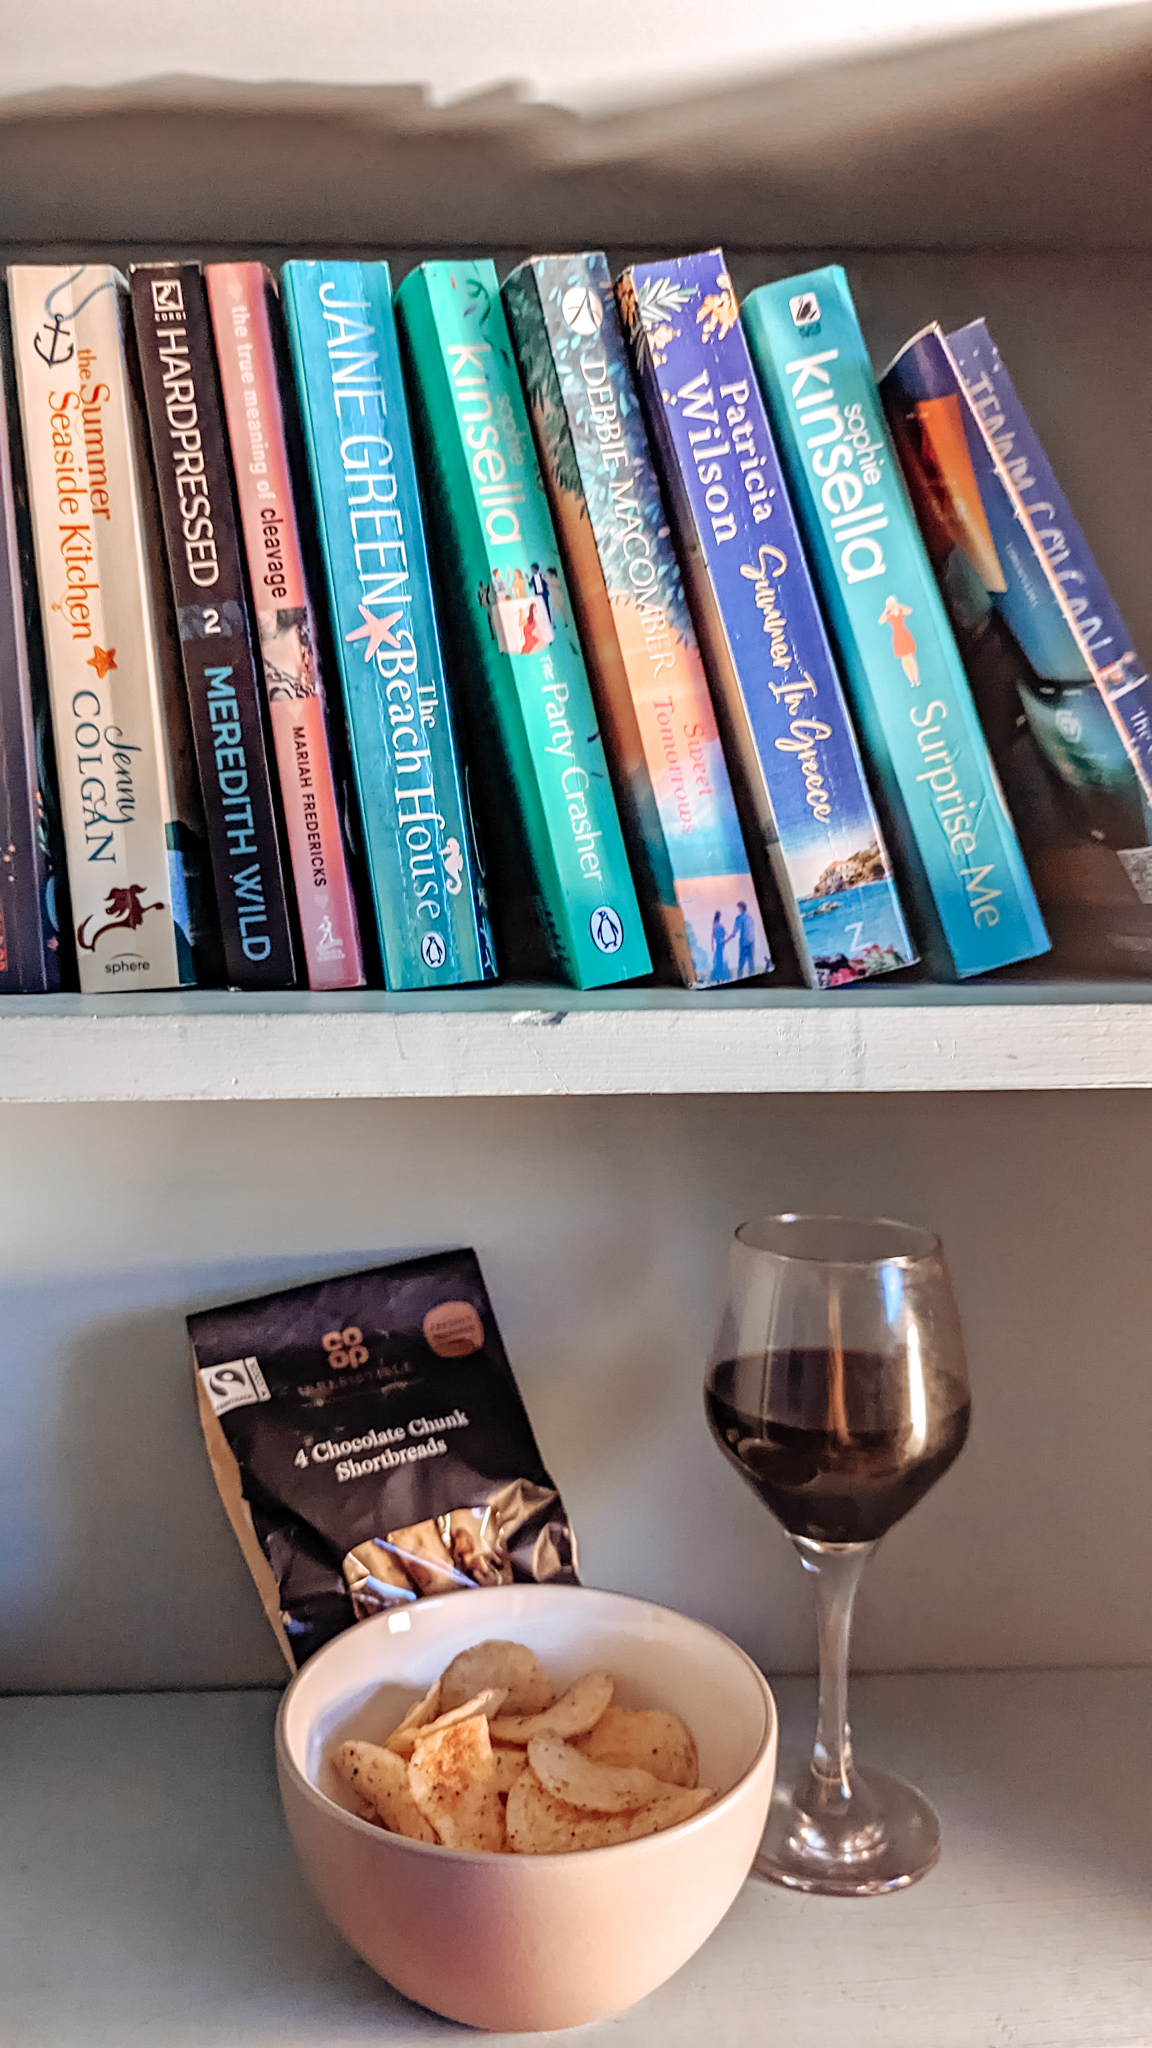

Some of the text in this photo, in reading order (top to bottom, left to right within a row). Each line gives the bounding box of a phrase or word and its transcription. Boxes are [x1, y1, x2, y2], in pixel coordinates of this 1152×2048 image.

[49, 389, 100, 640] Seaside Kitchen
[77, 348, 111, 521] the Summer
[156, 327, 221, 635] HARDPRESSED 2
[231, 304, 287, 599] the true meaning of cleavage
[318, 281, 413, 606] JANE GREEN
[446, 344, 526, 546] kinsella
[579, 359, 676, 679] DEBBIE MACOMBER
[677, 369, 738, 546] Wilson
[719, 378, 777, 525] Patricia
[784, 349, 890, 585] kinsella
[843, 402, 884, 486] sophie
[416, 679, 440, 730] The
[653, 695, 695, 834] Tomorrows
[683, 722, 713, 796] Sweet
[739, 543, 833, 825] Summer In Greece
[72, 689, 116, 864] COLGAN
[97, 725, 142, 826] Jenny
[204, 665, 272, 962] MEREDITH WILD
[292, 726, 327, 888] MARIAH FREDERICKS
[376, 629, 446, 920] Beach House
[540, 681, 577, 757] Party
[560, 765, 604, 881] Crasher
[909, 700, 1003, 931] Surprise Me
[105, 957, 150, 975] sphere
[294, 1408, 470, 1469] 4 Chocolate Chunk
[335, 1436, 448, 1483] Shortbreads
